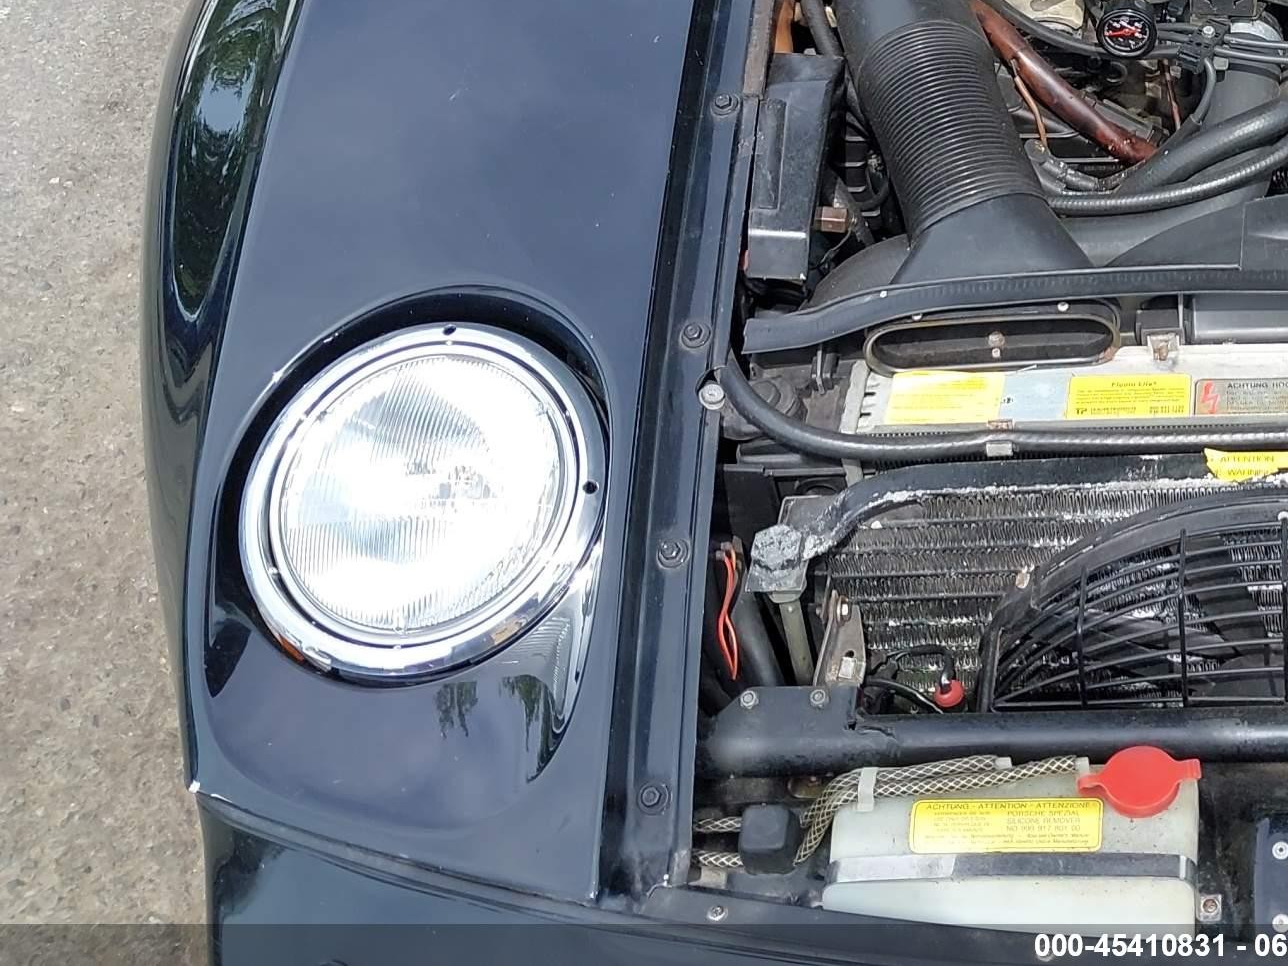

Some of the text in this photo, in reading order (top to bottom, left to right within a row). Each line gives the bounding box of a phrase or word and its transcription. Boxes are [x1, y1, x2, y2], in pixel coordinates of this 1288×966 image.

[1226, 381, 1269, 389] ACHTUNG
[1219, 455, 1275, 464] ATTENTION
[926, 803, 969, 811] ACHTUNG
[978, 802, 1027, 810] ATTENTION
